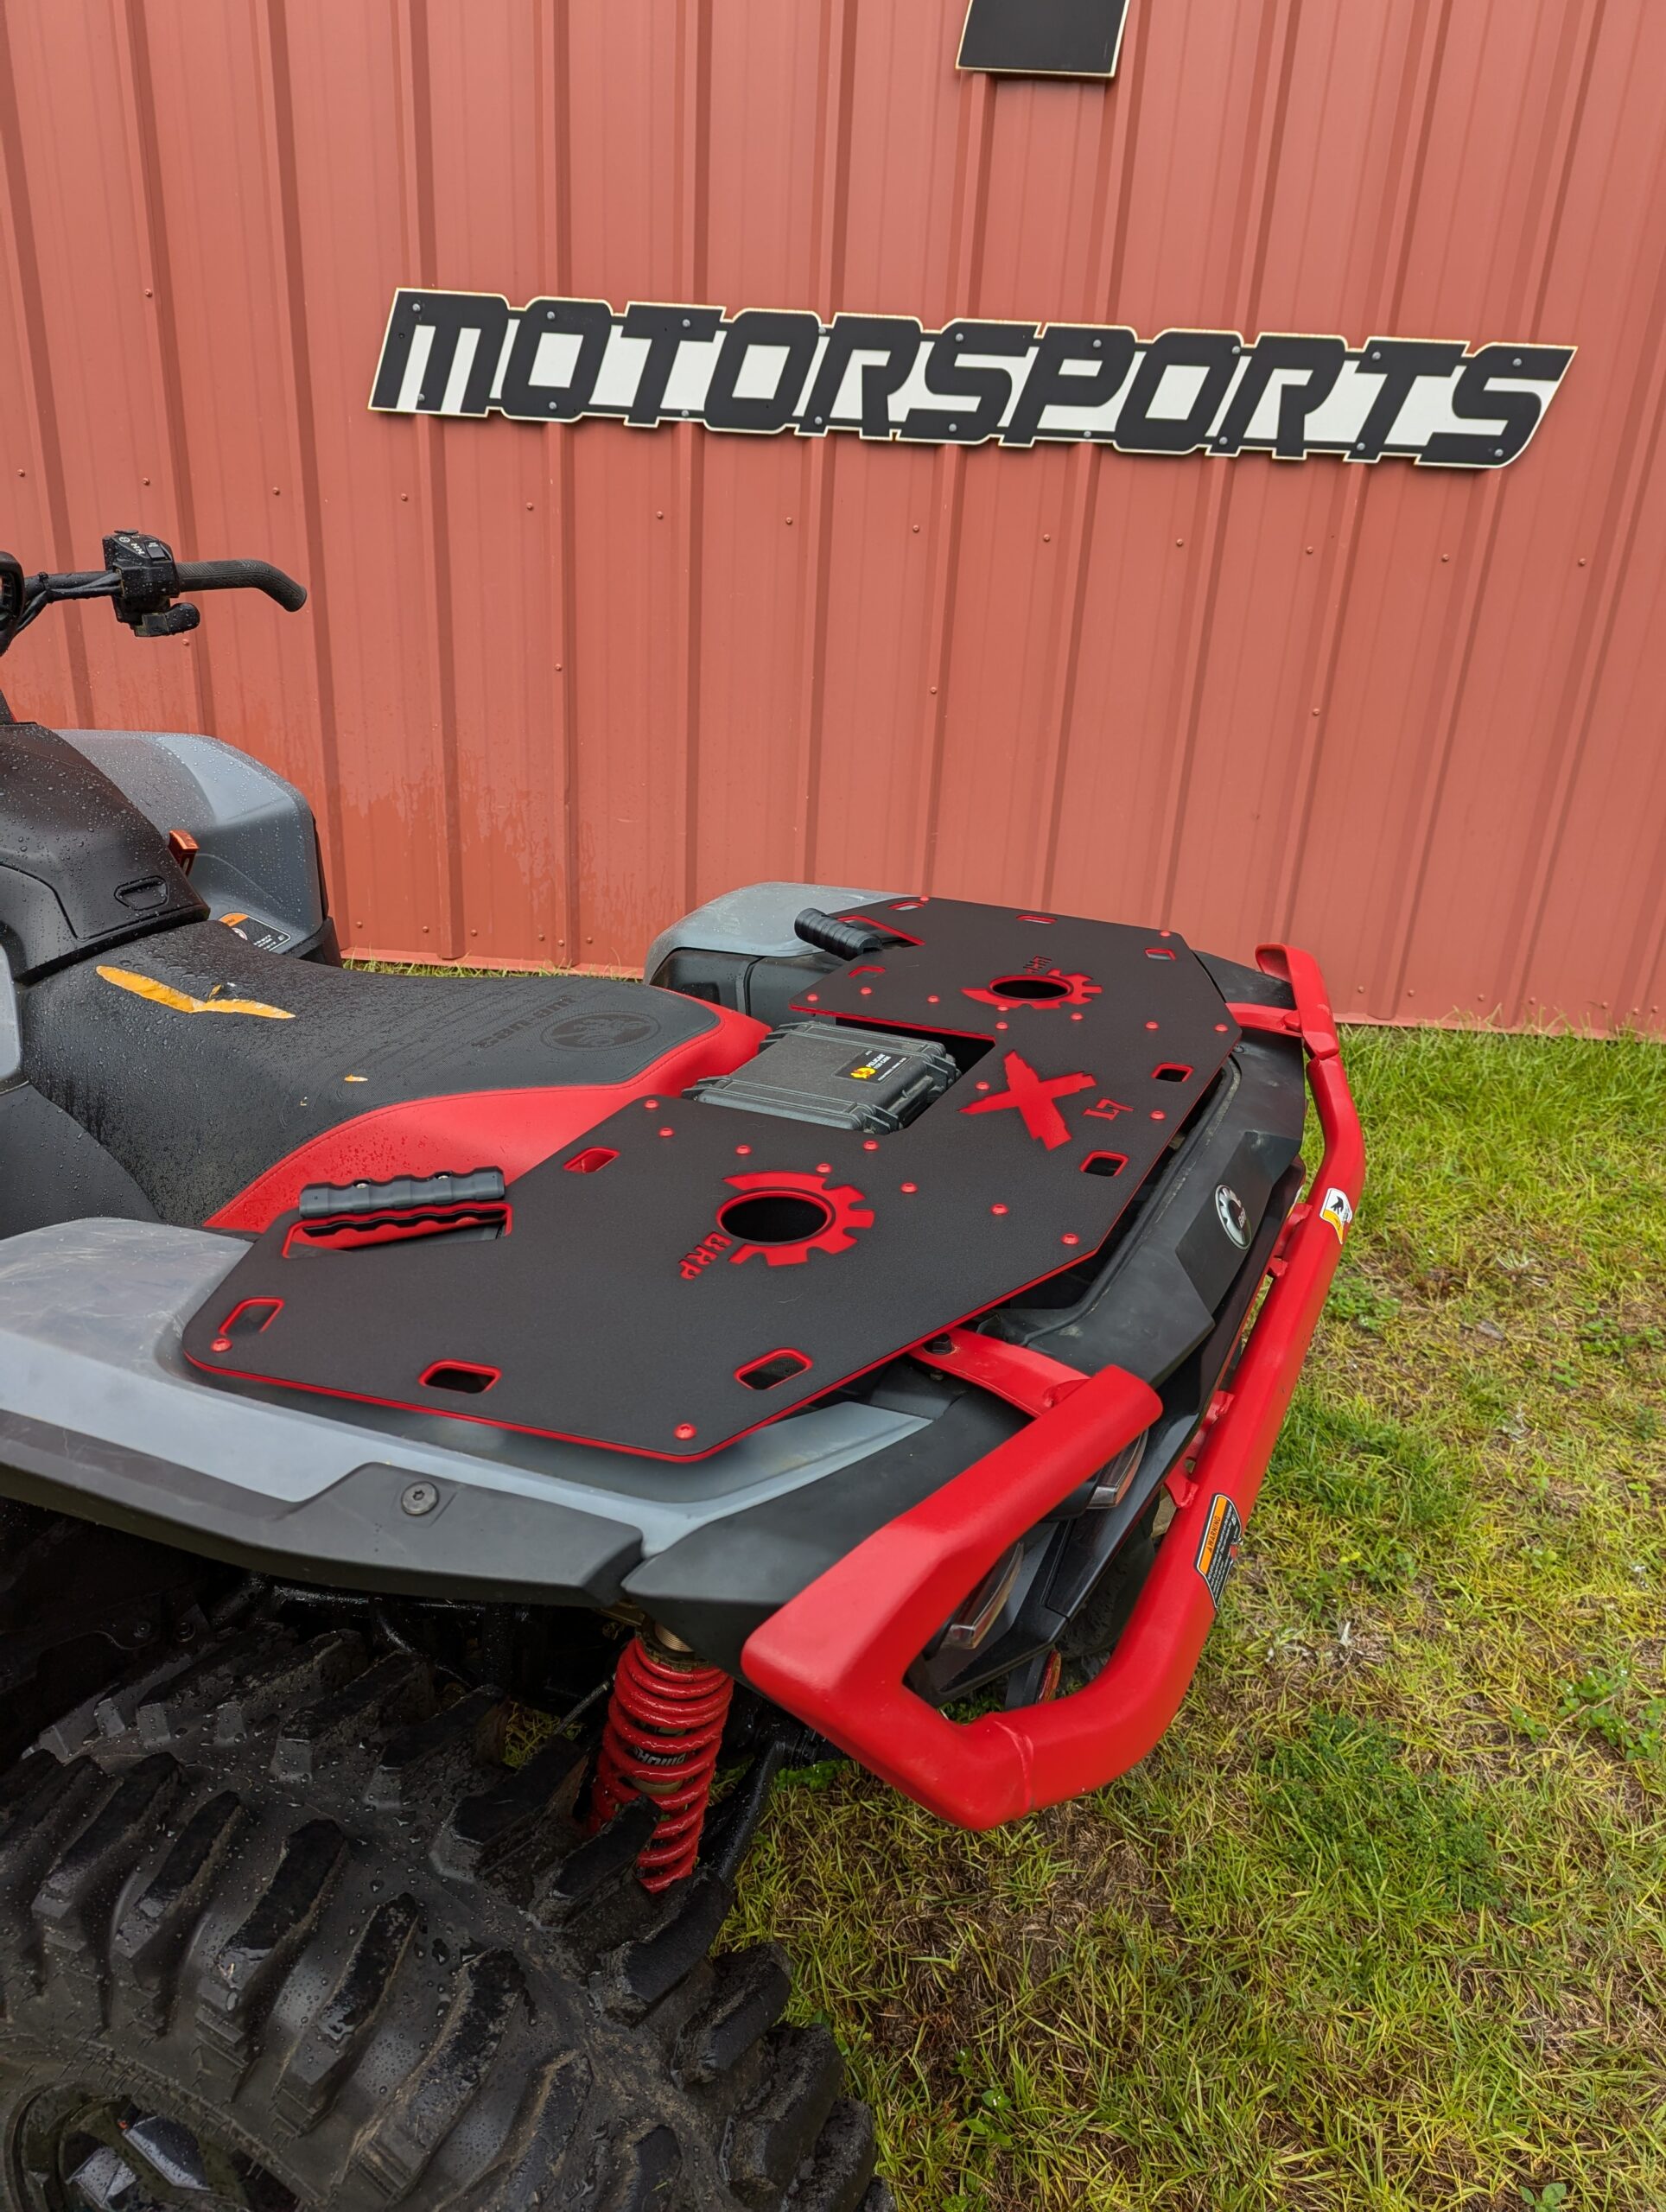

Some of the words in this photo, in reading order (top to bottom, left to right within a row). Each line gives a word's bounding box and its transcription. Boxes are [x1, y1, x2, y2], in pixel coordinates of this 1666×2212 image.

[370, 289, 1577, 469] MOTORSPORTS
[678, 1231, 734, 1281] BRP
[1207, 1516, 1221, 1548] WARNING
